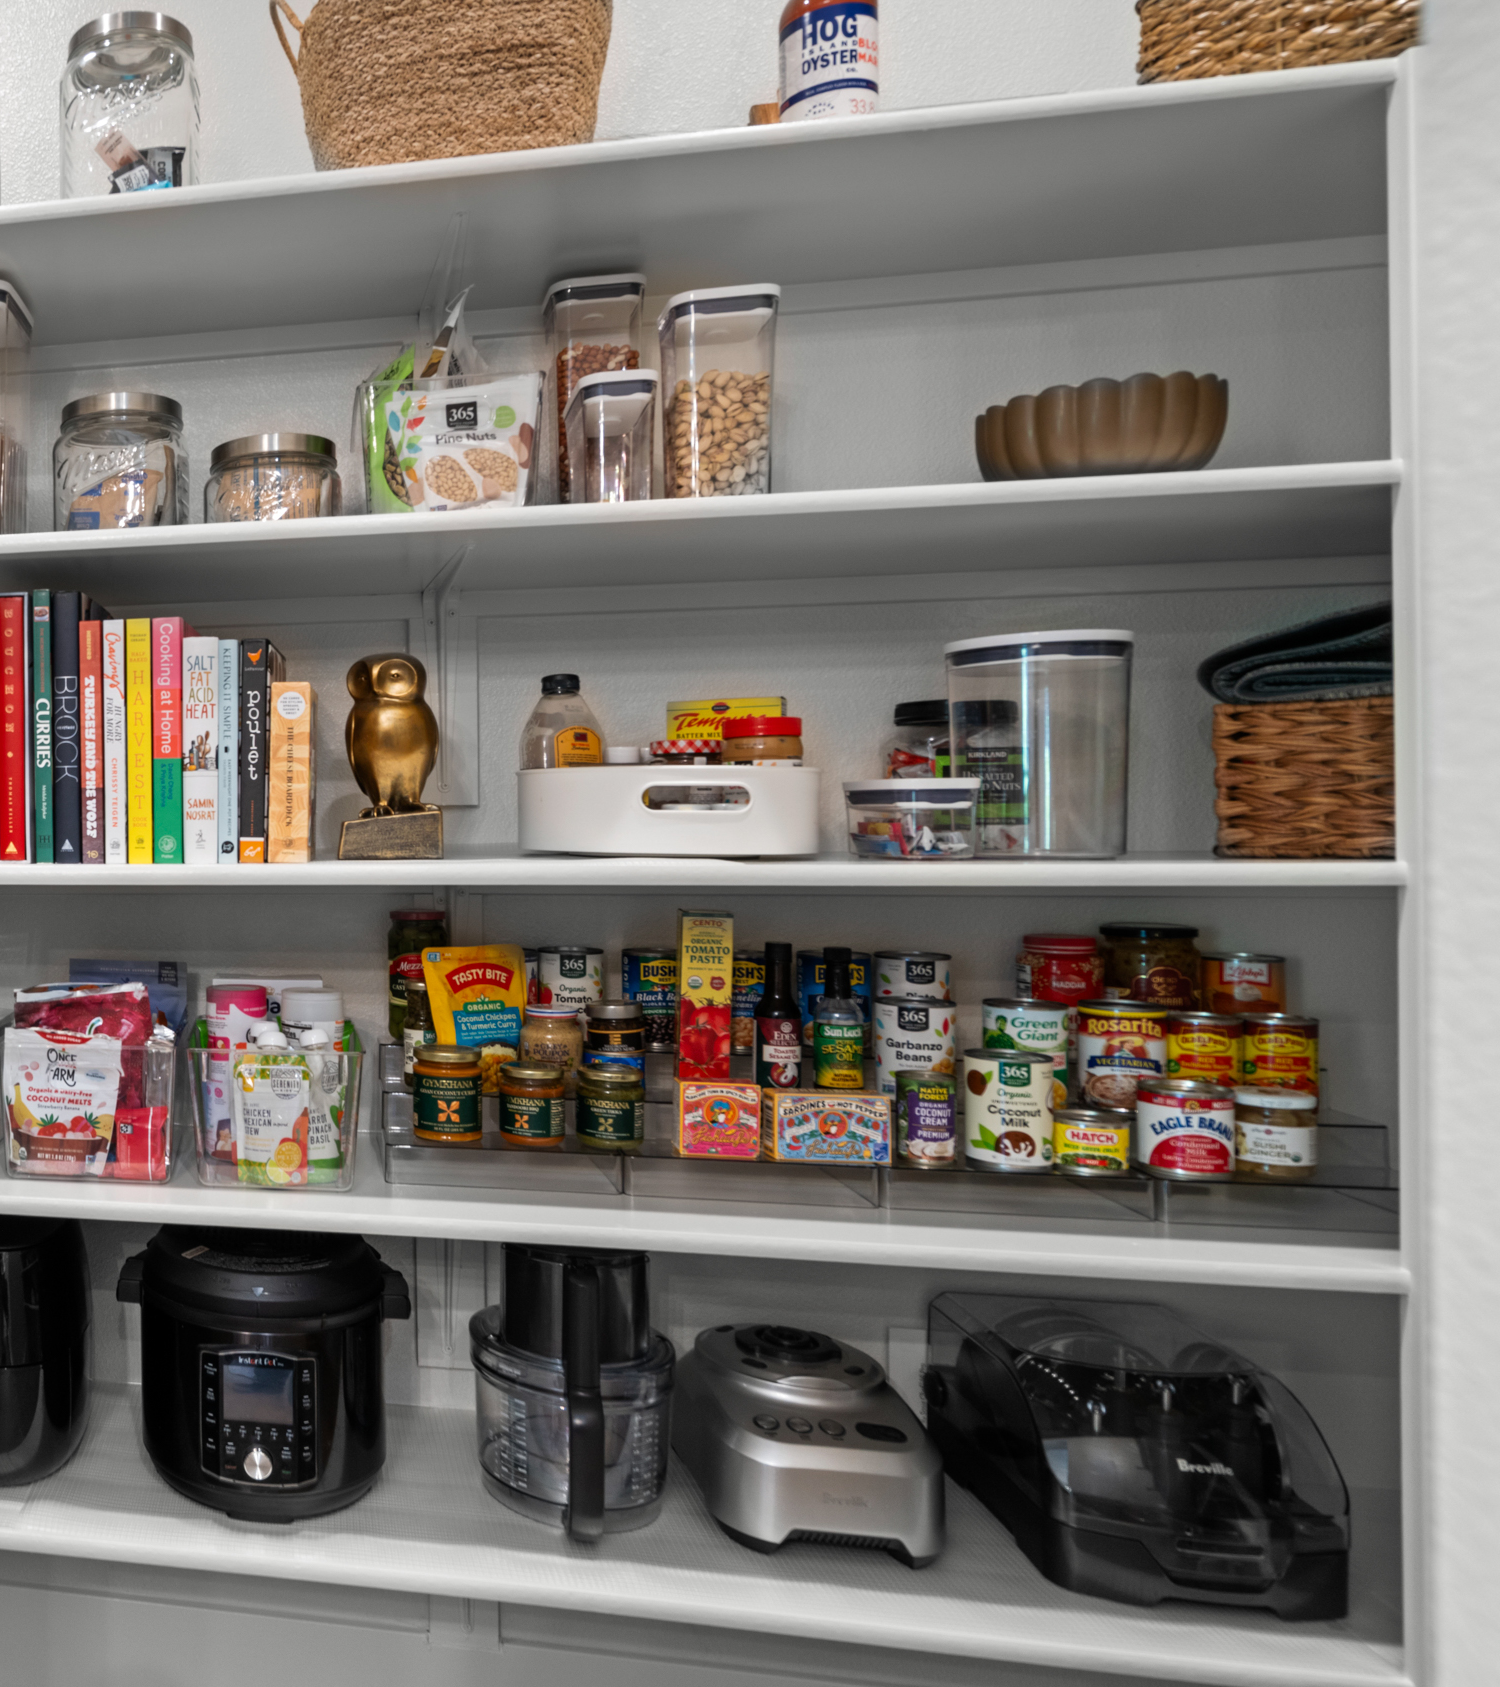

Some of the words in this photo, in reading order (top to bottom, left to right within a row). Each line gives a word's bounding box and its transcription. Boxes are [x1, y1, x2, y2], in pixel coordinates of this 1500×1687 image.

[802, 14, 858, 50] HOG
[802, 39, 858, 58] ISLAND
[802, 49, 858, 75] OYSTER
[449, 407, 475, 421] 365
[435, 433, 463, 445] Pine
[466, 432, 497, 441] Nuts
[157, 623, 174, 686] Cooking
[103, 632, 125, 699] Cravings
[187, 655, 215, 671] SALT
[223, 648, 232, 690] KEEPING
[3, 608, 15, 733] BOUCHON
[190, 671, 212, 687] FAT
[160, 690, 173, 706] at
[188, 687, 214, 703] ACID
[223, 694, 231, 702] IT
[84, 675, 96, 741] TURKEY
[186, 703, 216, 719] HEAT
[54, 675, 79, 783] BROCK
[114, 705, 122, 744] HUNGRY
[223, 705, 232, 741] SIMPLE
[35, 698, 51, 769] CURRIES
[160, 710, 174, 754] Home
[85, 741, 96, 769] AND
[85, 771, 97, 798] THE
[286, 777, 294, 804] BOARD
[187, 798, 215, 809] SAMIN
[86, 799, 98, 838] WOLF
[186, 810, 216, 820] NOSRAT
[285, 805, 293, 827] DECK
[692, 919, 723, 927] CENTO
[690, 938, 723, 946] ORGANIC
[684, 945, 730, 956] TOMATO
[562, 959, 584, 971] 365
[690, 955, 724, 965] PASTE
[908, 964, 933, 976] 365
[452, 968, 484, 986] TASTY
[485, 968, 510, 984] BITE
[559, 984, 587, 993] Organic
[636, 992, 664, 1001] Black
[466, 1002, 502, 1011] ORGANIC
[456, 1014, 485, 1023] Coconut
[485, 1013, 518, 1022] Chickpea
[900, 1010, 927, 1024] 365
[1011, 1017, 1058, 1029] Green
[461, 1022, 467, 1030] &
[467, 1021, 496, 1030] Turmeric
[497, 1021, 516, 1030] Curry
[823, 1026, 843, 1037] Sun
[843, 1027, 863, 1037] Luck
[1087, 1018, 1163, 1037] Rosarita
[774, 1031, 797, 1040] EDEN
[1017, 1030, 1058, 1041] Giant
[821, 1044, 863, 1055] SESAME
[886, 1038, 943, 1051] Garbanzo
[46, 1048, 78, 1063] ONCE
[836, 1053, 855, 1062] OIL
[896, 1051, 933, 1063] Beans
[1094, 1058, 1156, 1070] VEGETARIAN
[1000, 1066, 1029, 1079] 365
[272, 1080, 300, 1089] SERENITY
[422, 1078, 474, 1089] GYMKHANA
[28, 1086, 53, 1094] Organic
[433, 1088, 460, 1096] COCONUT
[919, 1087, 948, 1095] NATIVE
[997, 1088, 1033, 1099] Organic
[26, 1095, 66, 1104] COCONUT
[67, 1097, 92, 1106] MELTS
[919, 1093, 948, 1101] FOREST
[37, 1103, 63, 1111] Strawberry
[243, 1108, 271, 1118] CHICKEN
[783, 1100, 826, 1116] SARDINES
[837, 1101, 854, 1109] HOT
[854, 1103, 885, 1119] PEPPER
[915, 1107, 952, 1117] COCONUT
[987, 1104, 1042, 1117] Coconut
[244, 1118, 272, 1127] MEXICAN
[920, 1117, 948, 1126] CREAM
[1001, 1117, 1030, 1128] Milk
[245, 1127, 260, 1136] STEW
[917, 1130, 950, 1140] PREMIUM
[1150, 1117, 1193, 1135] EAGLE
[1198, 1117, 1234, 1141] BRAND
[310, 1134, 331, 1145] BASIL
[1071, 1130, 1115, 1143] HATCH
[1169, 1138, 1221, 1150] Condensed
[1252, 1140, 1287, 1149] SUSHI
[1247, 1149, 1293, 1158] GINGER
[238, 1356, 264, 1365] Instant
[264, 1357, 278, 1367] Pot
[1175, 1457, 1235, 1476] Breville
